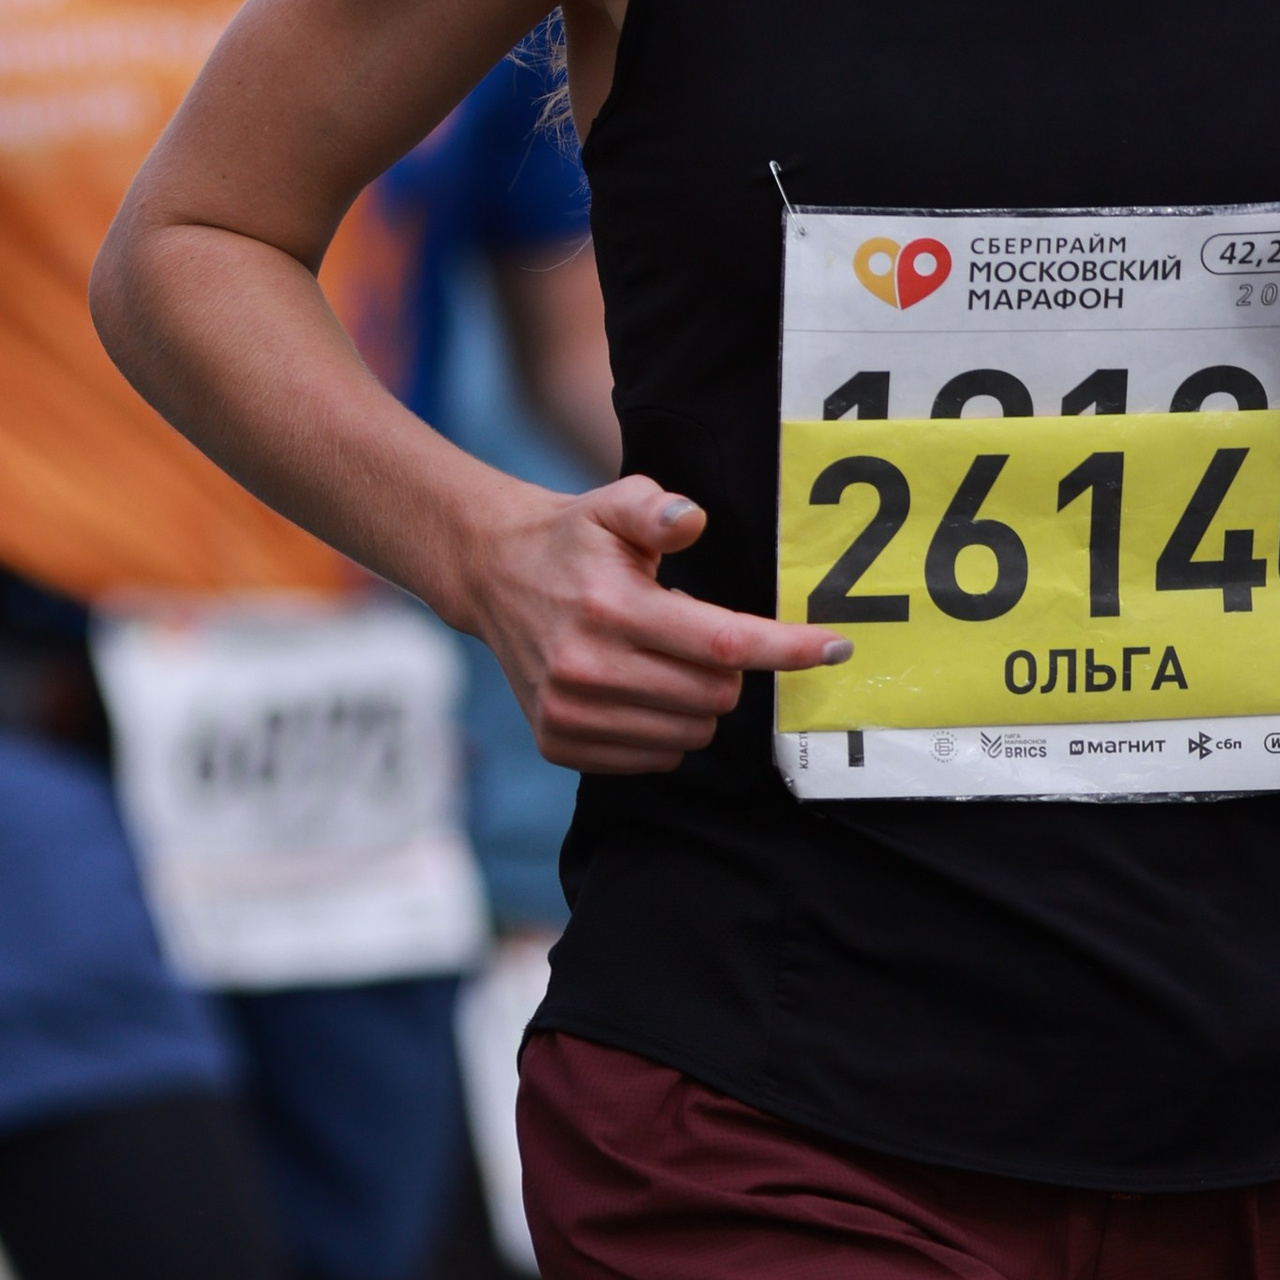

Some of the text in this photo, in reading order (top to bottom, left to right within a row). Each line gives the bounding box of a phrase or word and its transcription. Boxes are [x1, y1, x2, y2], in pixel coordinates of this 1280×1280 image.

[970, 232, 1127, 255] СБЕРПРАЙМ
[968, 254, 1182, 283] МОСКОВСКИЙ
[967, 287, 1125, 311] МАРАФОН
[1004, 646, 1189, 695] ОЛЬГА
[799, 731, 808, 769] КЛАСТ
[1005, 746, 1047, 758] BRICS
